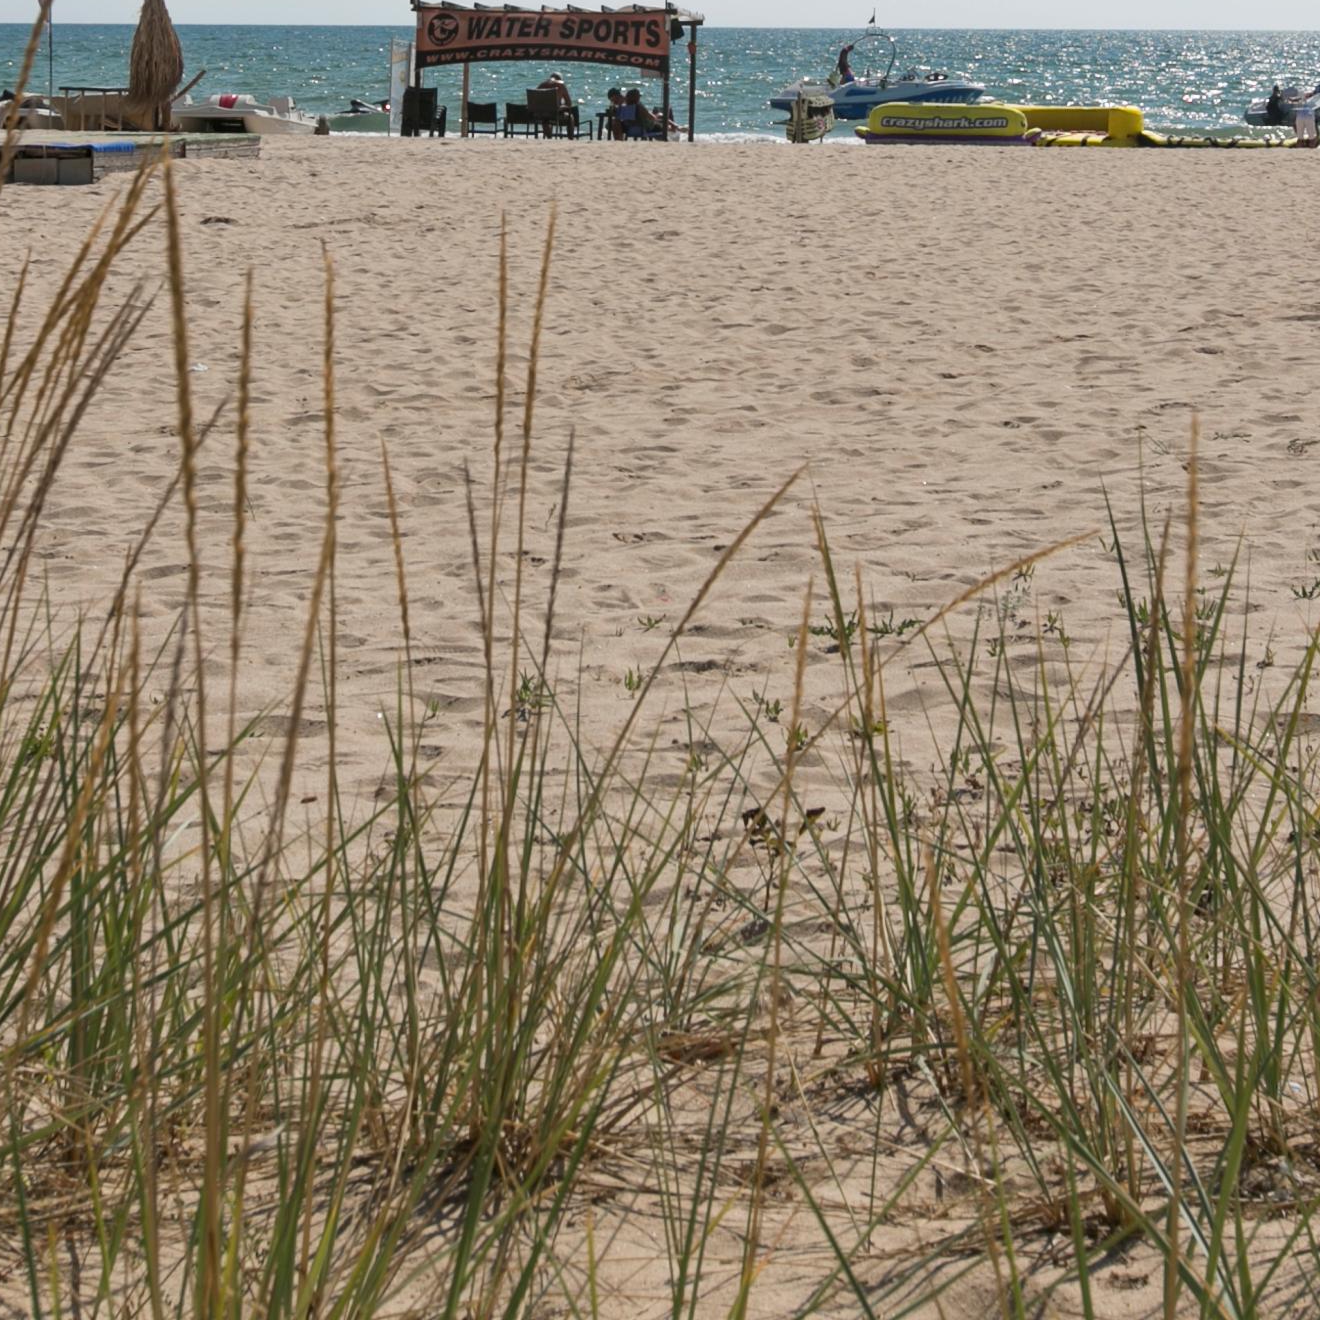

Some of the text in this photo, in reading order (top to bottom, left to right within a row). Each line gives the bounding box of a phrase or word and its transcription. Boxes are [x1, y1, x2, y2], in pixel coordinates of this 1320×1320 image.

[467, 15, 661, 48] WATER SPORTS
[426, 46, 661, 66] WWW.CRAZYSHARK.COM
[882, 117, 1007, 129] crazyshark.com
